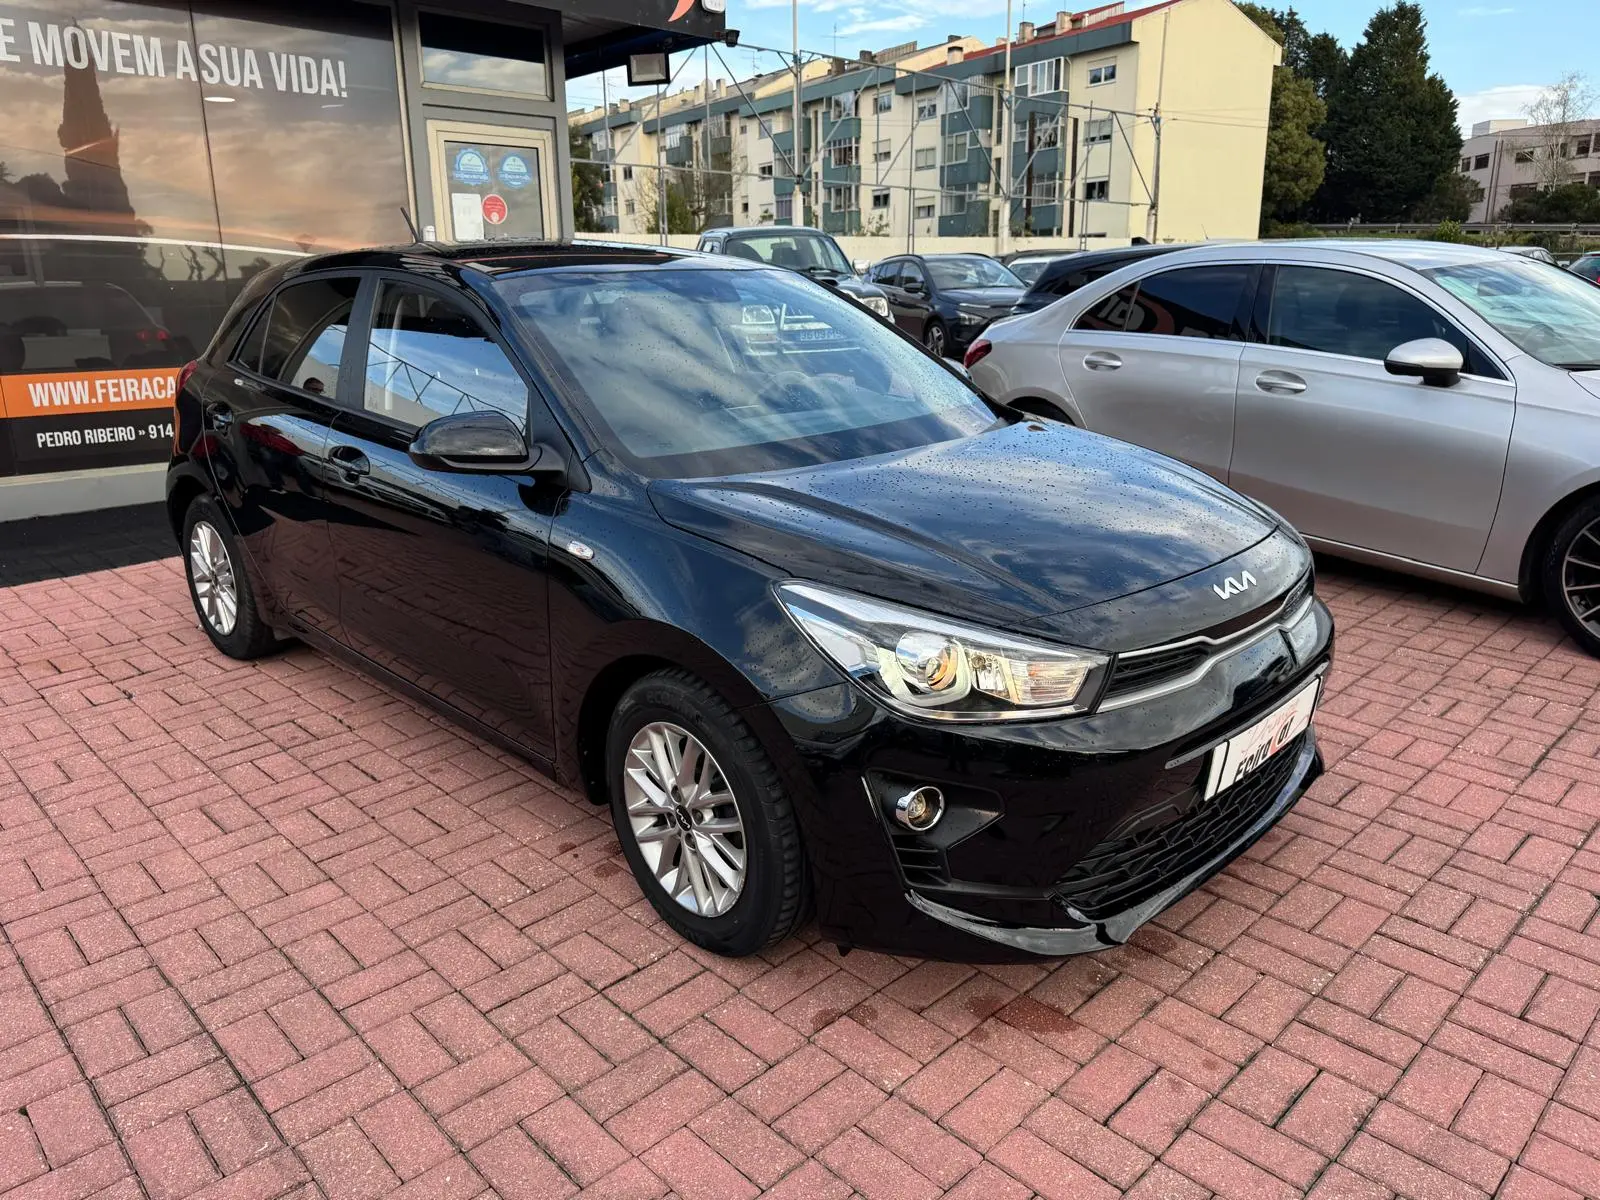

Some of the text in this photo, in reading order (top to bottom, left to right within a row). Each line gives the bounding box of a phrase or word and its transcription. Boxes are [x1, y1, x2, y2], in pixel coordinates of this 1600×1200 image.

[27, 20, 165, 78] MOVEM
[268, 52, 348, 98] VIDA!
[36, 430, 81, 448] PEDRO
[84, 426, 136, 444] RIBEIRO
[148, 423, 174, 439] 914
[1213, 570, 1257, 600] KIA
